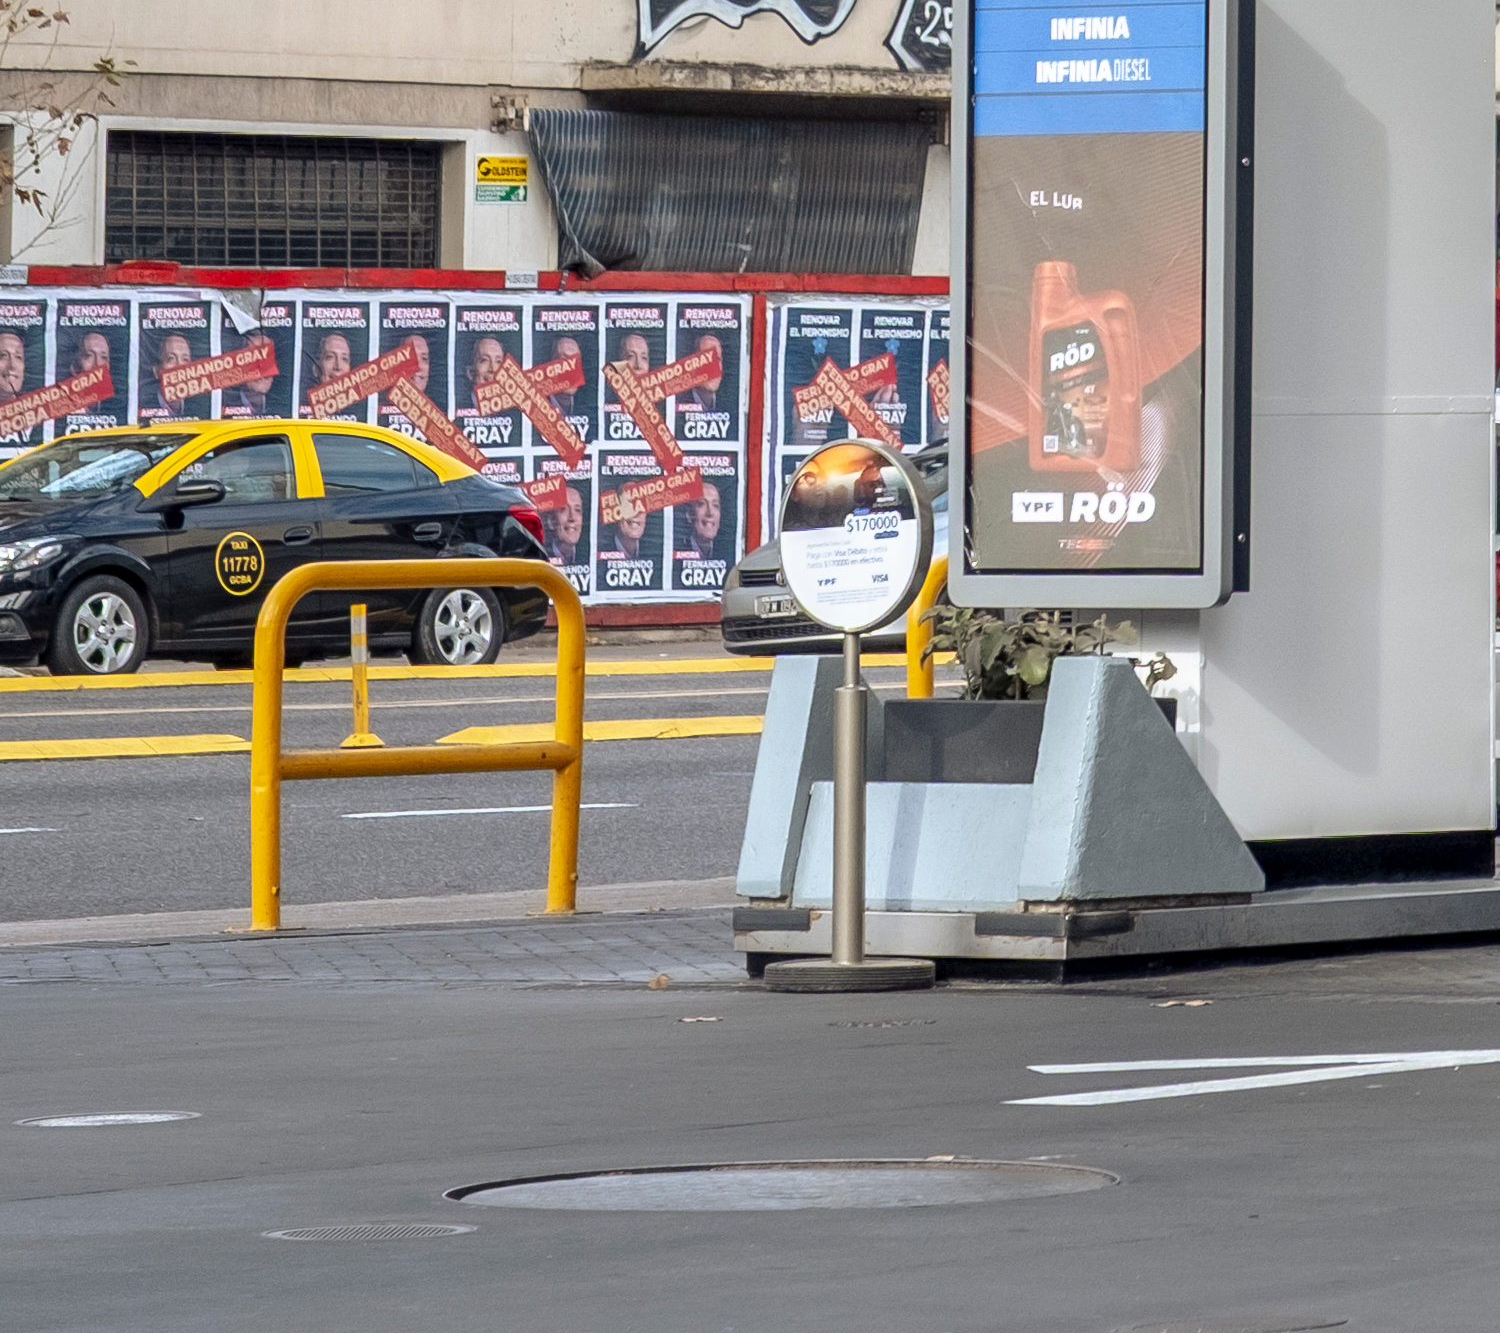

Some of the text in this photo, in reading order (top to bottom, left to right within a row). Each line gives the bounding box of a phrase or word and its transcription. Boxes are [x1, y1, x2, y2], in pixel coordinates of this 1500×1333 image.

[1050, 16, 1130, 40] INFINIA
[1030, 191, 1048, 206] EL
[67, 305, 120, 316] RENOVAR
[149, 308, 203, 319] RENOVAR
[309, 307, 361, 318] RENOVAR
[389, 307, 440, 319] RENOVAR
[463, 311, 514, 322] RENOVAR
[540, 311, 589, 322] RENOVAR
[610, 309, 659, 319] RENOVAR
[685, 309, 733, 319] RENOVAR
[162, 355, 235, 385] FERNANDO
[235, 347, 269, 367] GRAY
[684, 350, 714, 373] GRAY
[1050, 342, 1095, 372] RÖD
[311, 363, 378, 405] FERNANDO
[380, 346, 412, 371] GRAY
[546, 357, 578, 380] GRAY
[165, 377, 213, 401] ROBA
[496, 369, 533, 416] ROBA
[314, 389, 361, 418] ROBA
[389, 388, 428, 432] ROBA
[503, 359, 557, 423] FERNANDO
[556, 422, 585, 453] GRAY
[400, 376, 486, 465] FERNANDO GRAY
[464, 416, 512, 427] FERNANDO
[685, 412, 730, 422] FERNANDO
[684, 421, 730, 439] GRAY
[607, 456, 656, 466] RENOVAR
[667, 469, 697, 490] GRAY
[1023, 483, 1156, 523] YPF RÖD
[846, 515, 899, 533] $170000
[223, 555, 258, 572] 11778
[607, 559, 653, 570] FERNANDO
[682, 559, 727, 569] FERNANDO
[606, 569, 653, 587] GRAY
[681, 569, 727, 587] GRAY
[817, 573, 889, 587] YPF VISA
